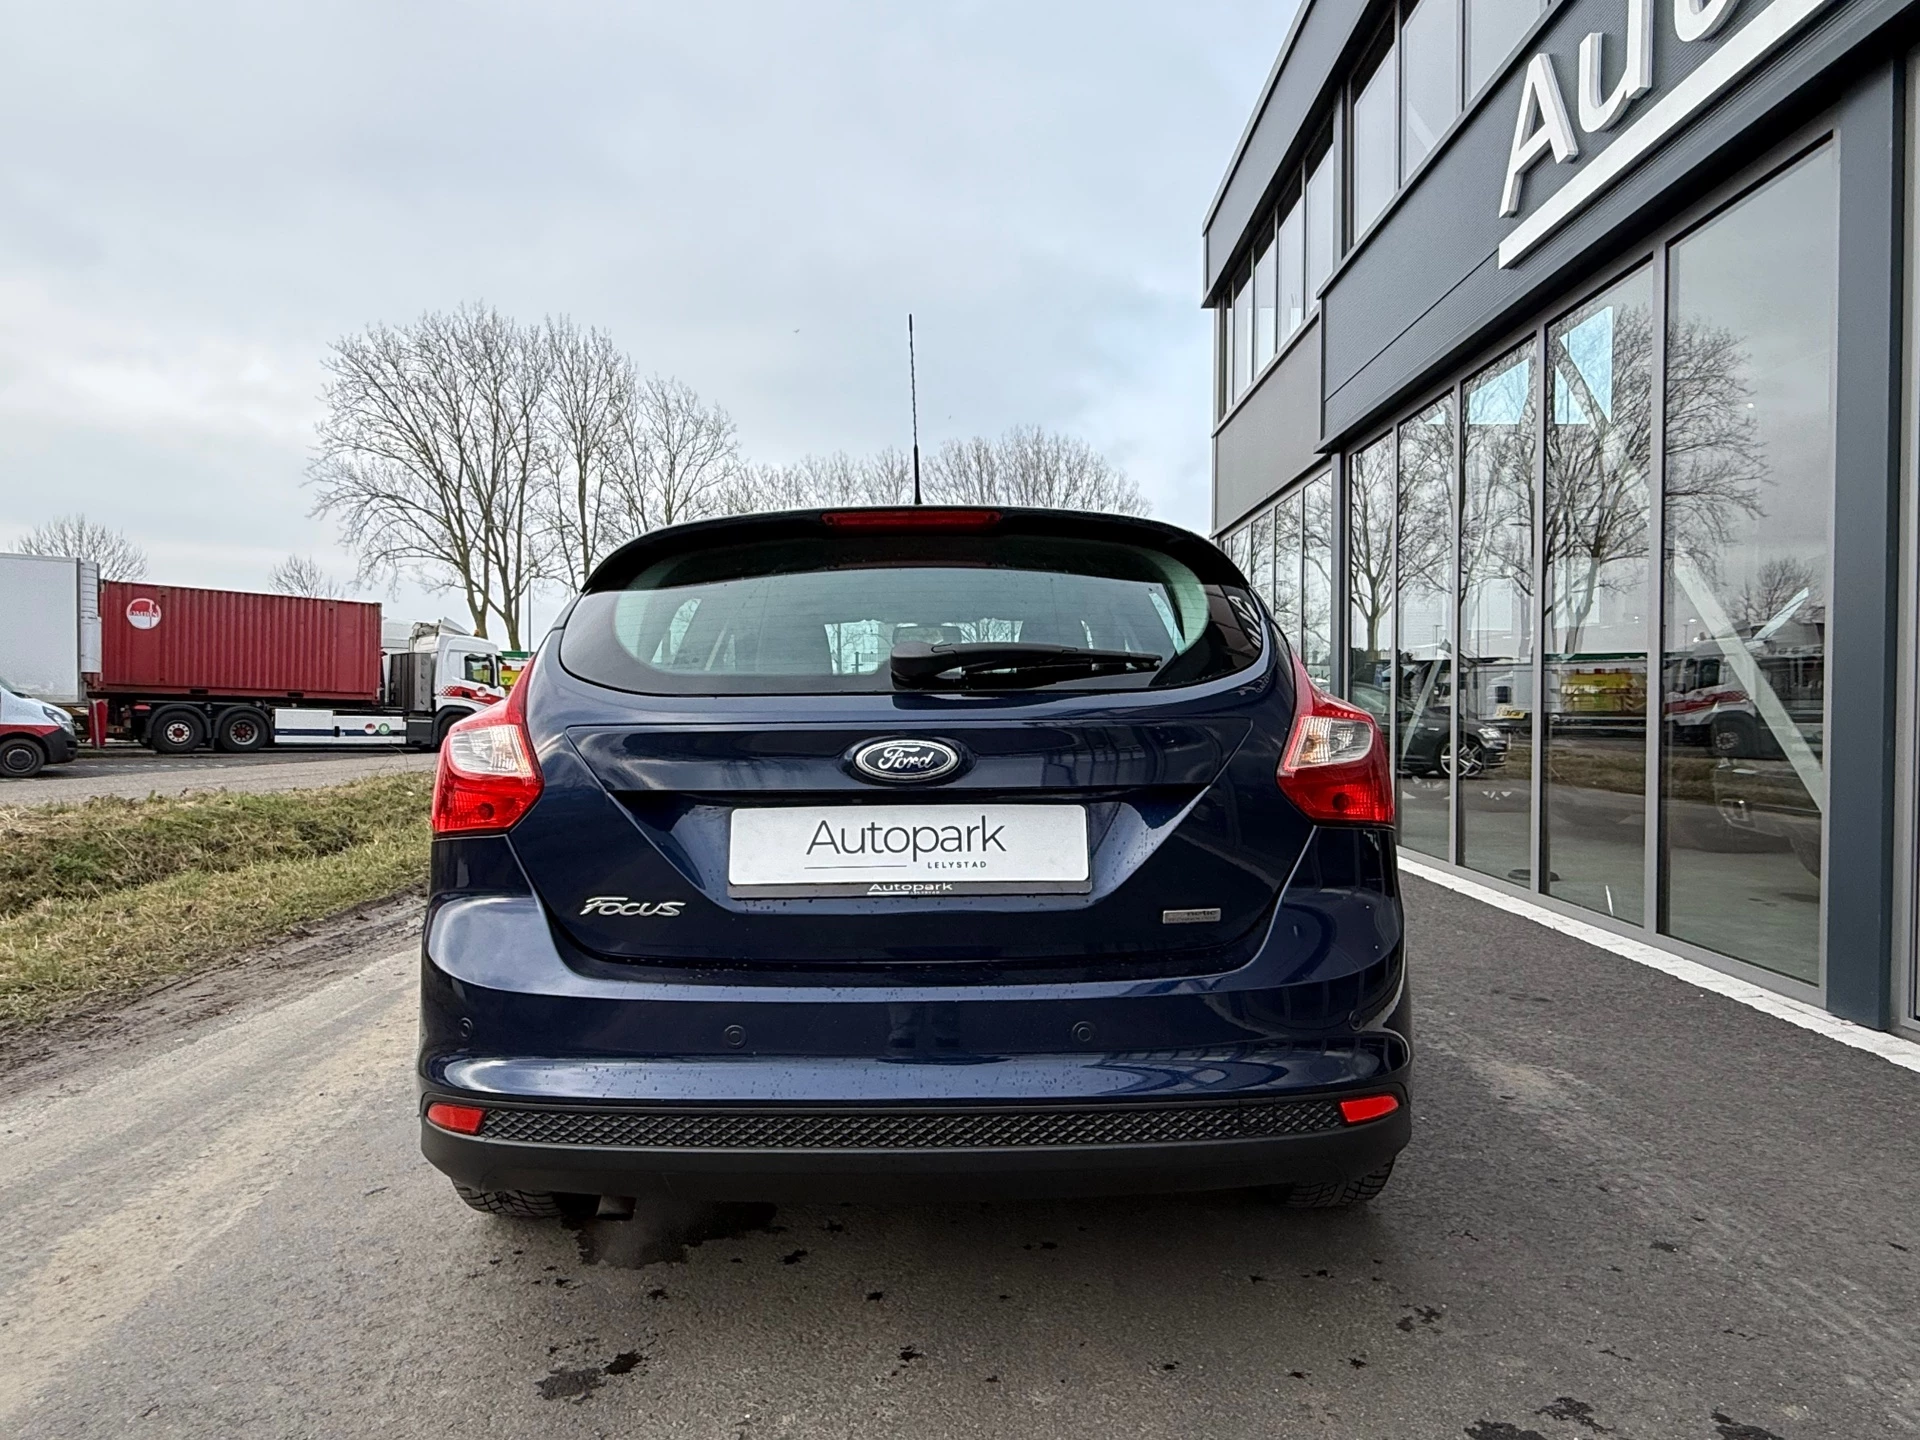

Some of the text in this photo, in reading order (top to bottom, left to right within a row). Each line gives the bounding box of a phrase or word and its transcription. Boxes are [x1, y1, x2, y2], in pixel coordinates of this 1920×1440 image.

[878, 746, 935, 769] Ford
[806, 815, 1007, 862] Autopark
[927, 861, 987, 869] LELYSTAD
[869, 882, 953, 892] Autopark
